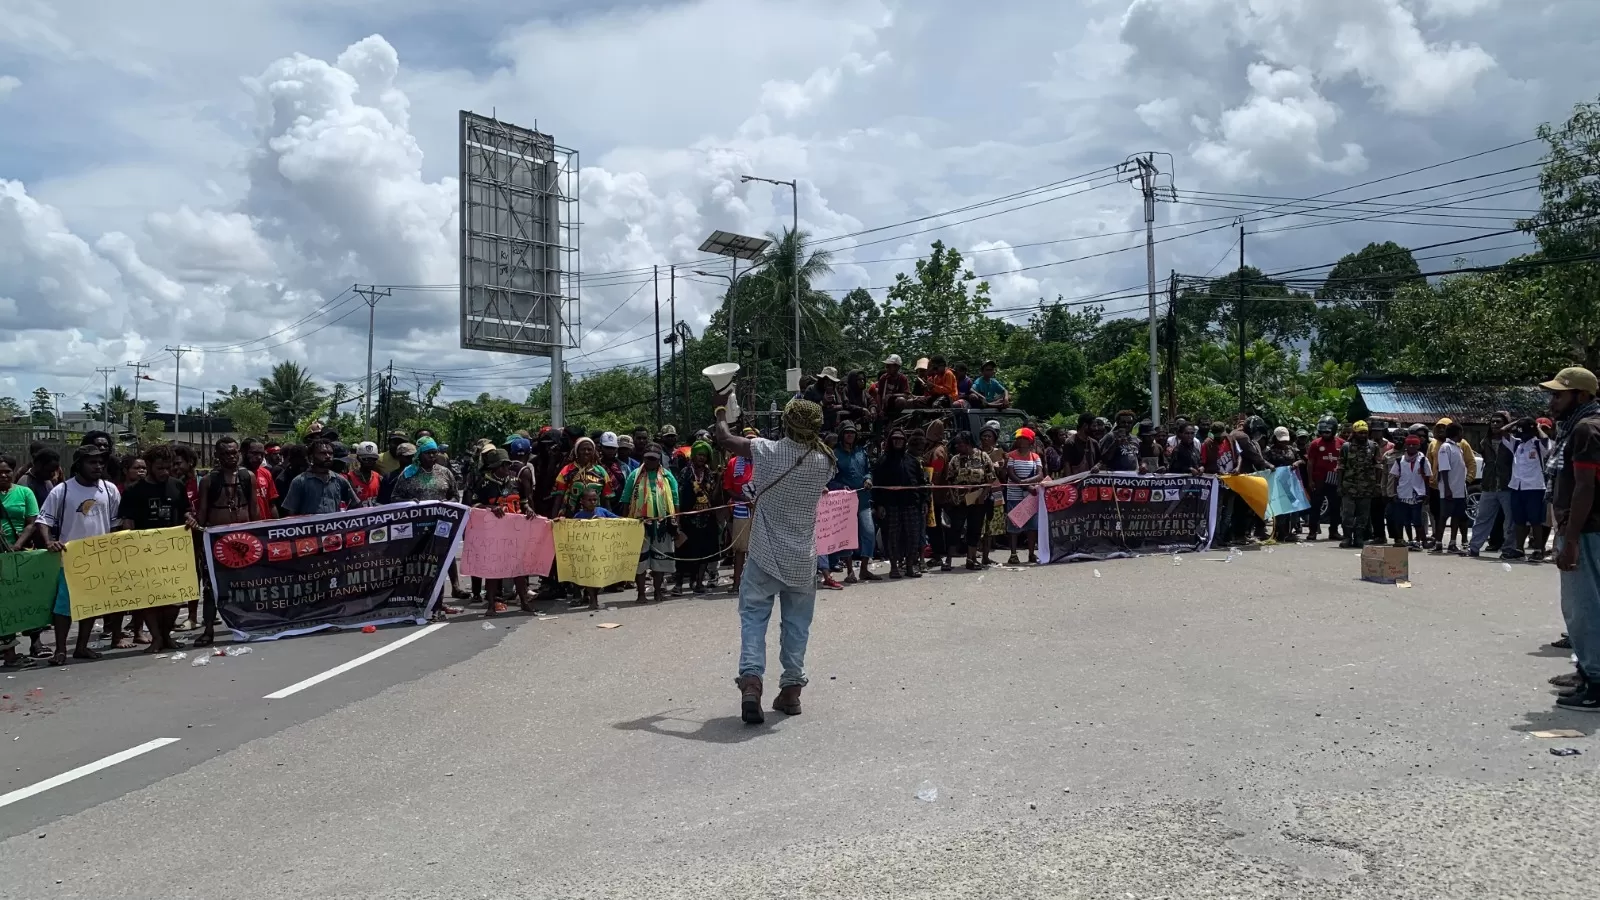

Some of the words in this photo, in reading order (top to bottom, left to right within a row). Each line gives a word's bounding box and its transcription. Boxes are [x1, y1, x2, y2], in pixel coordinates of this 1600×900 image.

[1083, 477, 1112, 487] FRONT
[1113, 479, 1151, 487] RAKYAT
[1151, 479, 1177, 487] PAPUA
[1177, 478, 1187, 486] DI
[268, 524, 314, 540] FRONT
[315, 517, 366, 534] RAKYAT
[367, 511, 409, 526] PAPUA
[410, 508, 422, 518] DI
[423, 506, 459, 519] TIMIKA
[1143, 529, 1169, 537] WEST
[567, 531, 622, 542] HENTIKAN
[73, 544, 140, 575] STOP
[154, 536, 192, 556] STOP
[83, 562, 189, 591] DISKRIMINASI
[230, 574, 294, 588] MENUNTUT
[298, 567, 340, 582] NEGARA
[343, 557, 402, 572] INDONESIA
[110, 576, 181, 596] RASISME
[227, 580, 320, 603] INVESTASI
[329, 577, 338, 589] &
[255, 602, 269, 611] DI
[271, 593, 326, 610] SELURUH
[328, 584, 367, 598] TANAH
[370, 578, 402, 590] WEST
[75, 597, 142, 617] TERHADAP
[147, 593, 177, 606] ORANG
